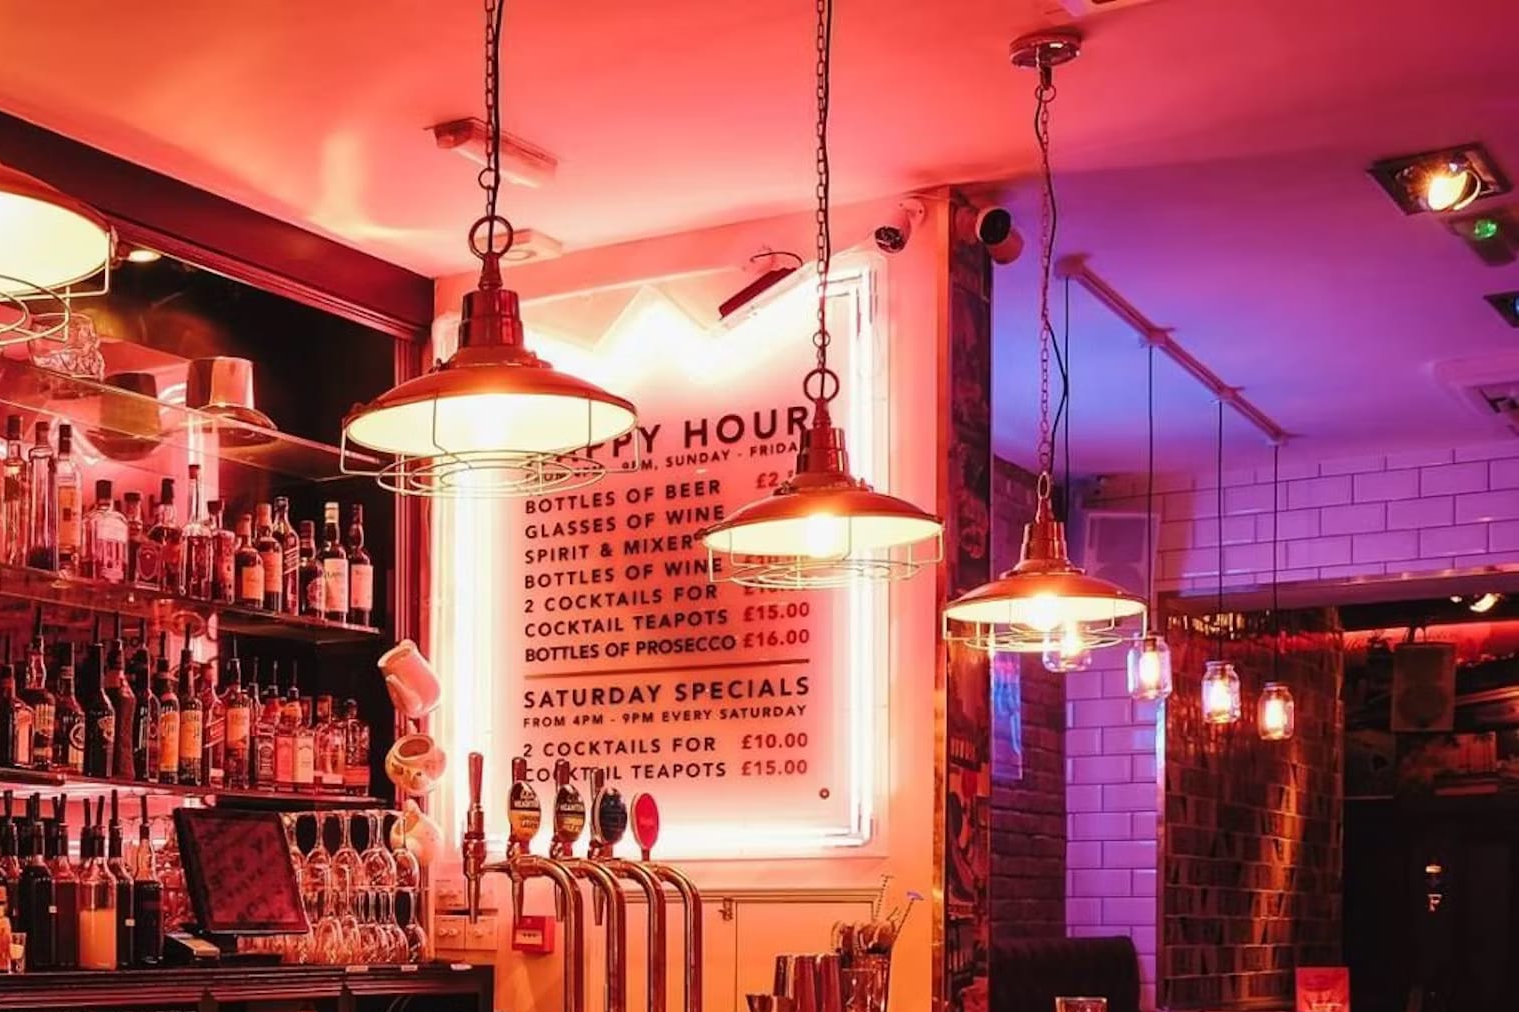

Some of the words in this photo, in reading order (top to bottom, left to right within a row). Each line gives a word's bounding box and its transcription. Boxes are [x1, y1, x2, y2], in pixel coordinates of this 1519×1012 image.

[684, 406, 808, 448] HOUR
[665, 449, 730, 468] SUNDAY
[750, 441, 798, 457] FRIDA
[525, 490, 616, 515] BOTTLES
[626, 486, 654, 504] OF
[665, 479, 721, 501] BEER
[525, 516, 616, 540] GLASSES
[626, 511, 655, 529] OF
[665, 505, 725, 526] WINE
[525, 544, 588, 565] SPIRIT
[600, 541, 613, 558] &
[624, 534, 693, 556] MIXER
[525, 566, 615, 590] BOTTLES
[625, 563, 654, 581] OF
[664, 557, 723, 577] WINE
[524, 599, 534, 614] 2
[544, 588, 662, 613] COCKTAILS
[673, 583, 717, 602] FOR
[524, 616, 624, 639] COCKTAIL
[632, 608, 728, 631] TEAPOTS
[742, 601, 810, 623] £15.00
[525, 642, 600, 663] BOTTLES
[604, 641, 630, 658] OF
[635, 634, 737, 657] PROSECCO
[742, 628, 810, 649] £16.00
[524, 684, 662, 709] SATURDAY
[674, 676, 809, 702] SPECIALS
[523, 715, 566, 728] FROM
[572, 713, 604, 726] 4PM
[622, 711, 654, 724] 9PM
[661, 709, 712, 723] EVERY
[719, 704, 807, 720] SATURDAY
[523, 743, 533, 758] 2
[543, 737, 661, 757] COCKTAILS
[672, 736, 716, 752] FOR
[741, 731, 809, 750] £10.00
[525, 764, 623, 783] COKTIL
[632, 761, 727, 780] TEAPOTS
[741, 759, 809, 777] £15.00
